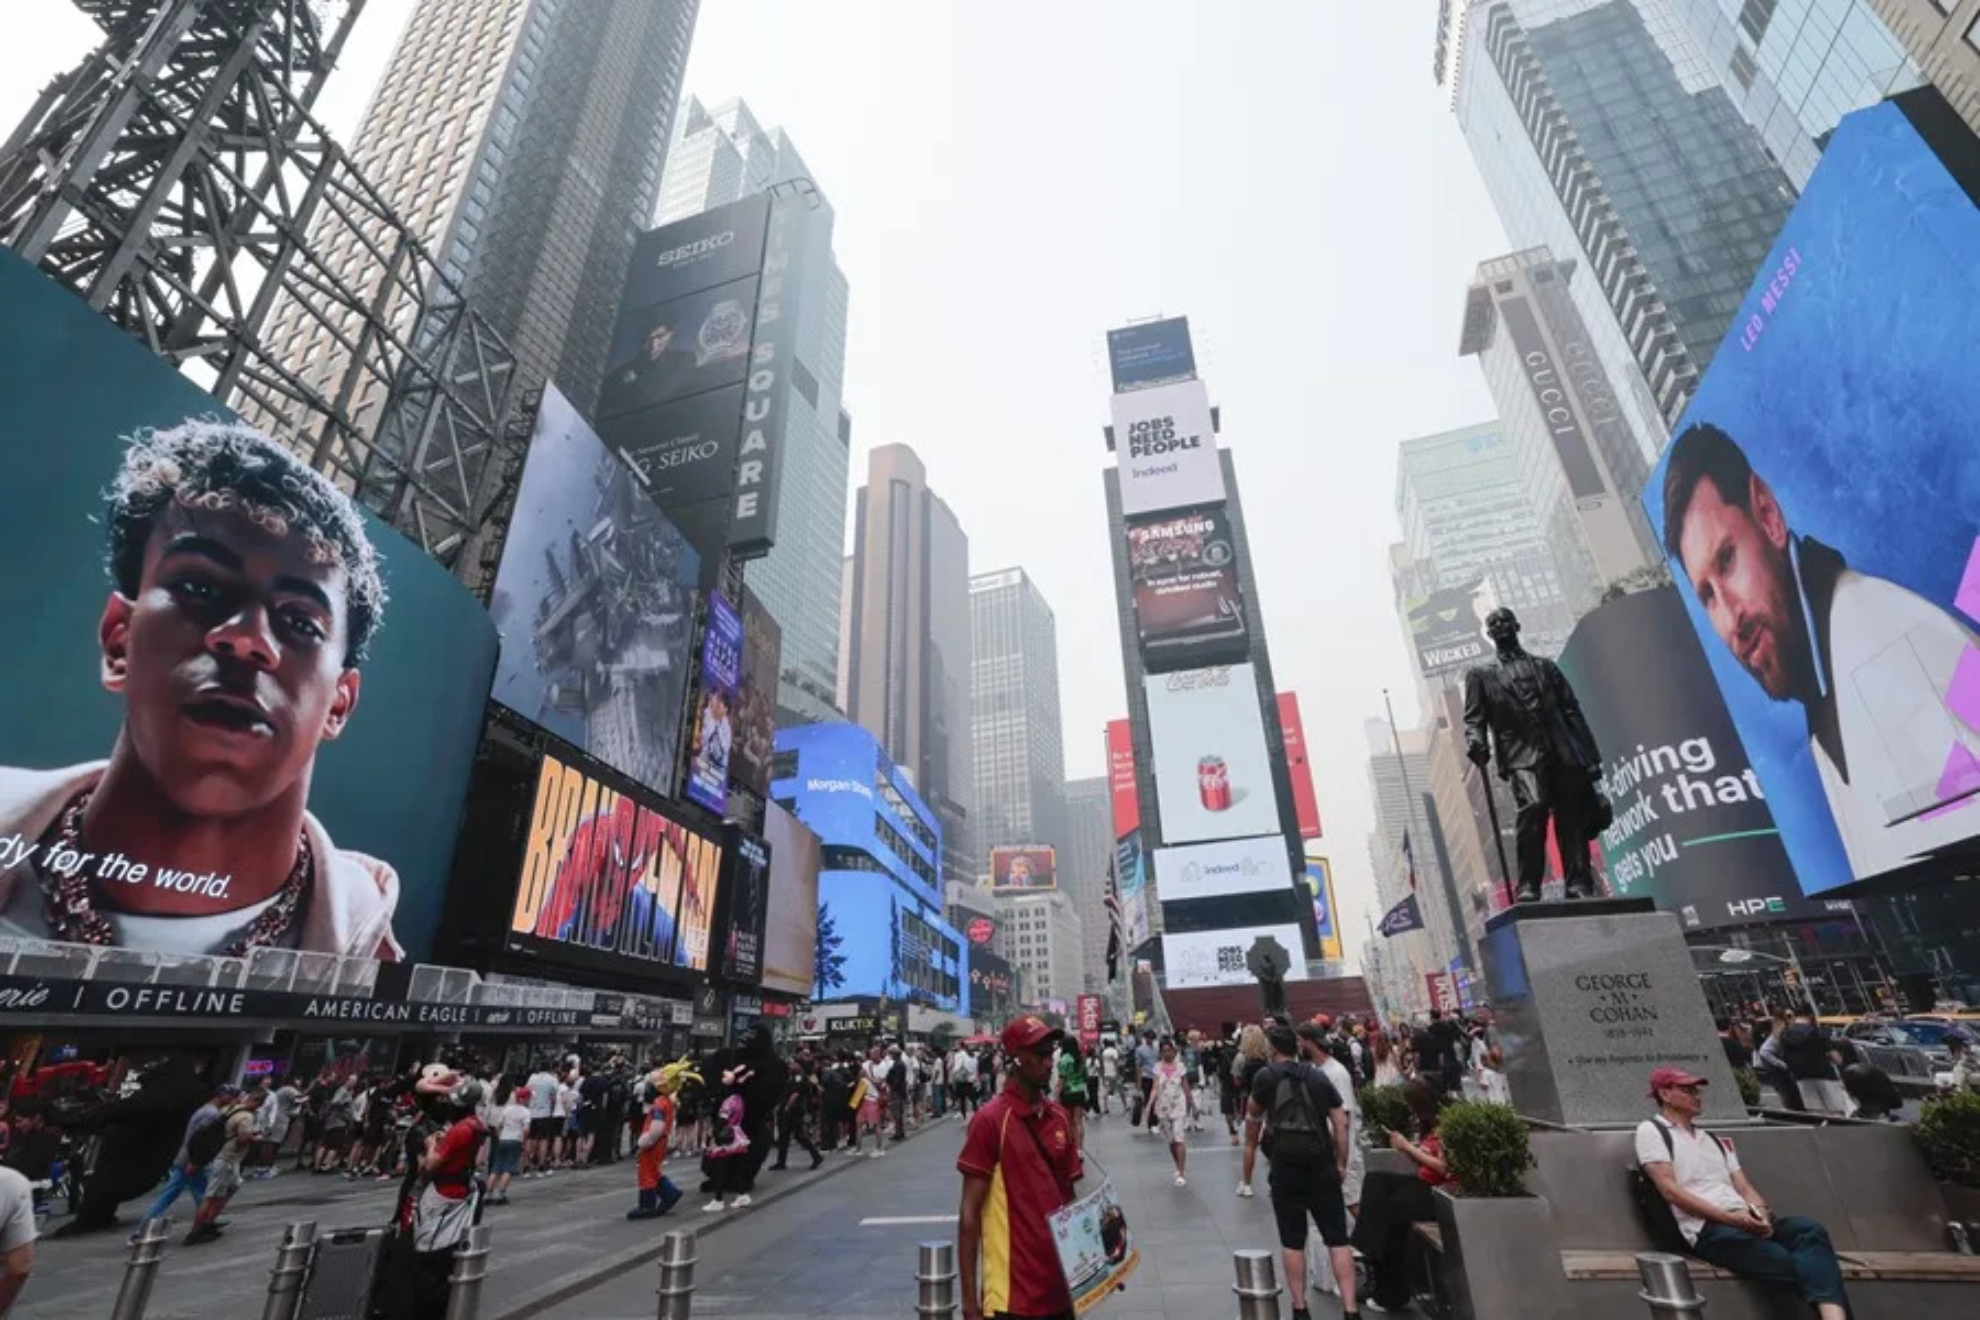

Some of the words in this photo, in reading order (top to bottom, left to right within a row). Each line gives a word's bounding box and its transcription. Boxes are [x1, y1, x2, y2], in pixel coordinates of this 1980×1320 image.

[657, 231, 735, 267] SEIKO
[1741, 313, 1763, 352] LEO
[1761, 247, 1802, 315] MESSI
[1525, 351, 1575, 435] GUCCI
[737, 341, 775, 519] SQUARE
[1128, 416, 1175, 434] JOBS
[1128, 429, 1176, 447] NEED
[658, 440, 719, 469] SEIKO
[1130, 435, 1201, 458] PEOPLE
[1139, 519, 1215, 543] SAMSUNG
[806, 778, 850, 793] Morgan
[1603, 789, 1659, 851] network
[1661, 767, 1766, 814] that
[42, 840, 95, 874] for
[96, 853, 148, 883] the
[154, 871, 231, 899] world.
[1614, 851, 1644, 893] gets
[1640, 832, 1679, 878] you
[1726, 897, 1786, 916] HPE
[1218, 961, 1247, 972] PEOP
[1575, 972, 1652, 992] GEORGE
[106, 987, 245, 1014] OFFLINE
[304, 999, 411, 1021] AMERICAN
[419, 1003, 467, 1023] EAGLE
[527, 1010, 577, 1025] OFFLINE
[1589, 1006, 1659, 1024] COHAN
